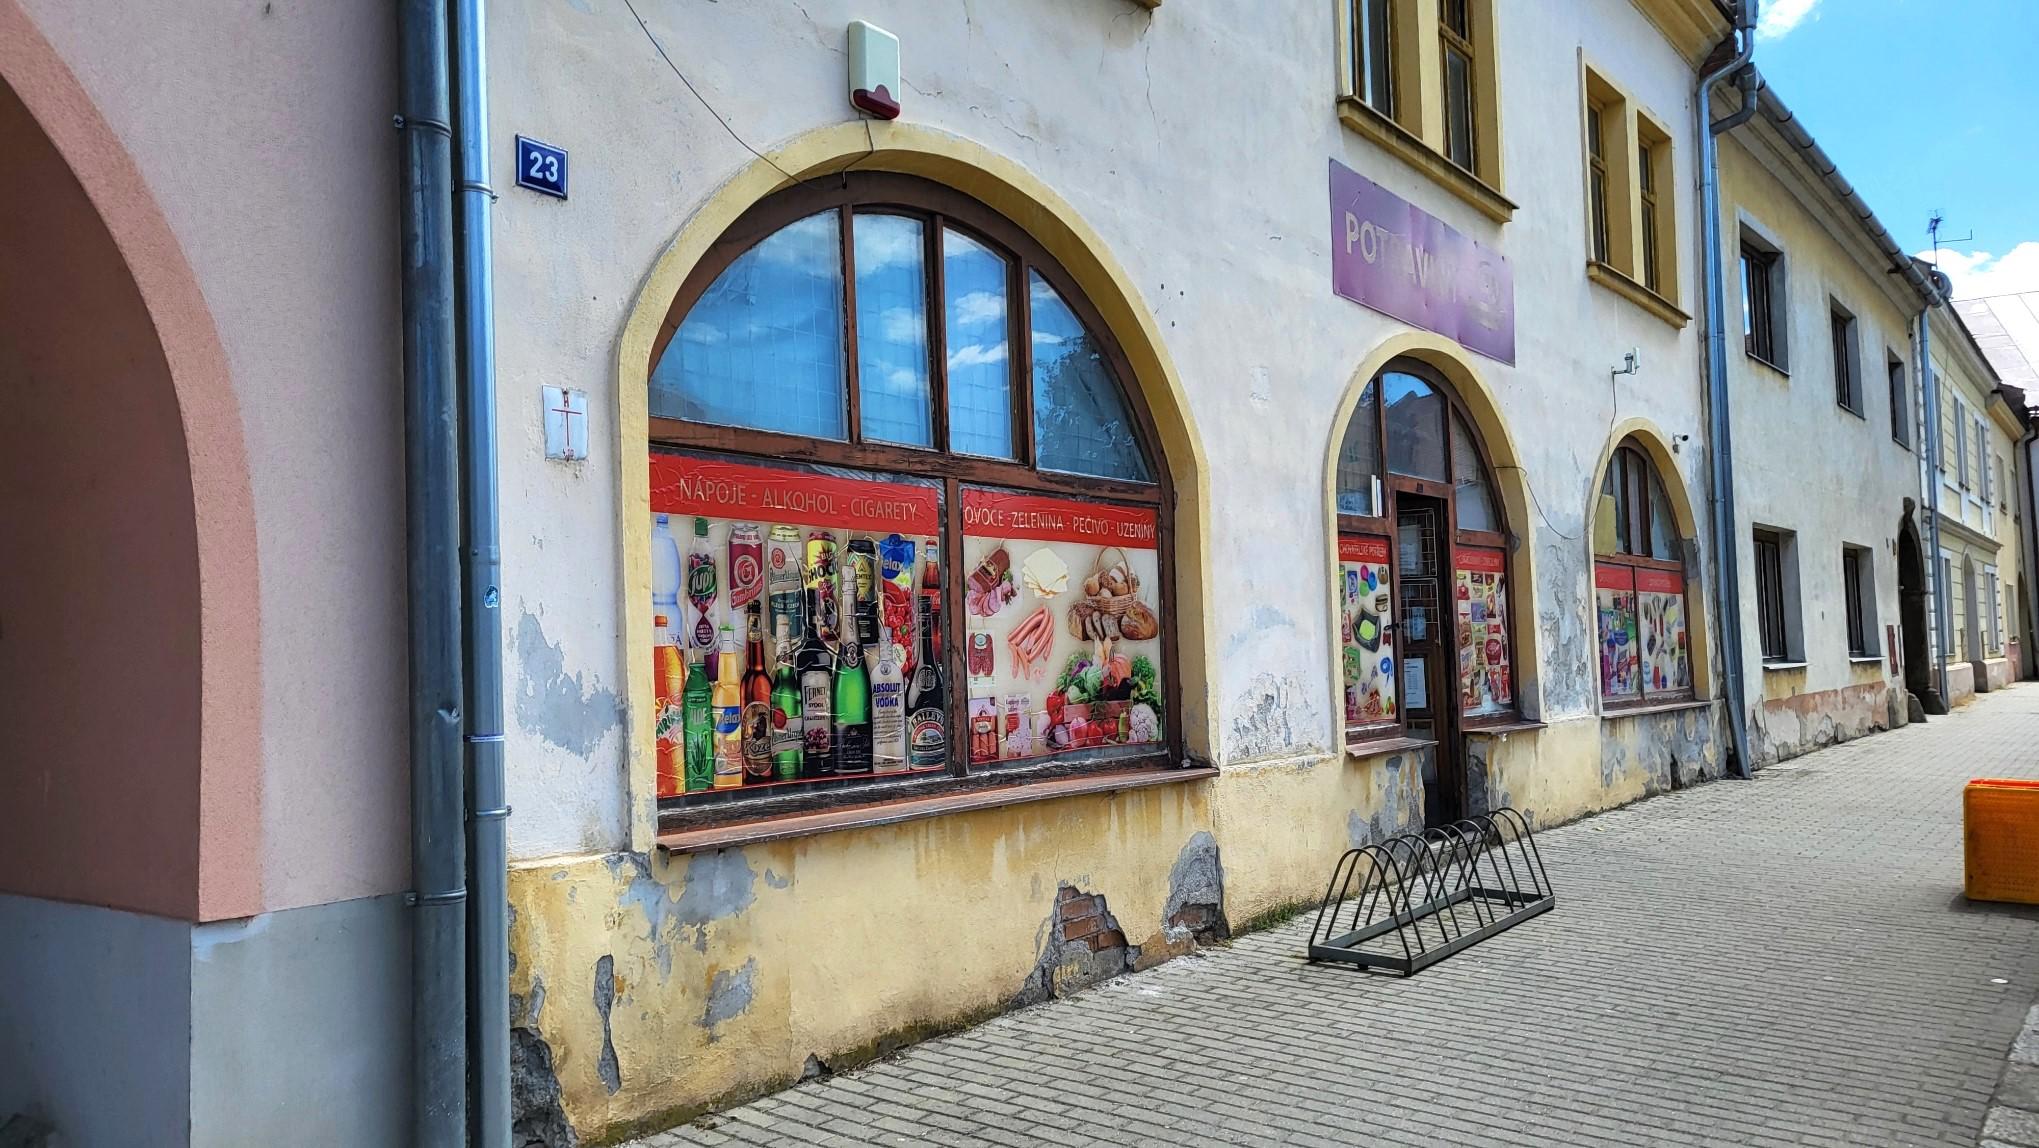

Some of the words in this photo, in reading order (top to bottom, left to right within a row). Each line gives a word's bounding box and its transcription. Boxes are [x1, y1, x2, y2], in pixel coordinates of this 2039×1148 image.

[529, 151, 559, 183] 23
[679, 476, 747, 505] NÁPOJE
[762, 488, 837, 515] ALKOHOL
[850, 499, 918, 521] CIGARETY
[964, 505, 1004, 527] OVOCE
[1011, 511, 1064, 531] ZELENINA
[1072, 516, 1109, 535] PEČIVO
[1116, 522, 1155, 540] UZENINY
[883, 559, 905, 572] elax
[872, 683, 901, 694] ABSOLUT
[875, 697, 899, 708] VODKA
